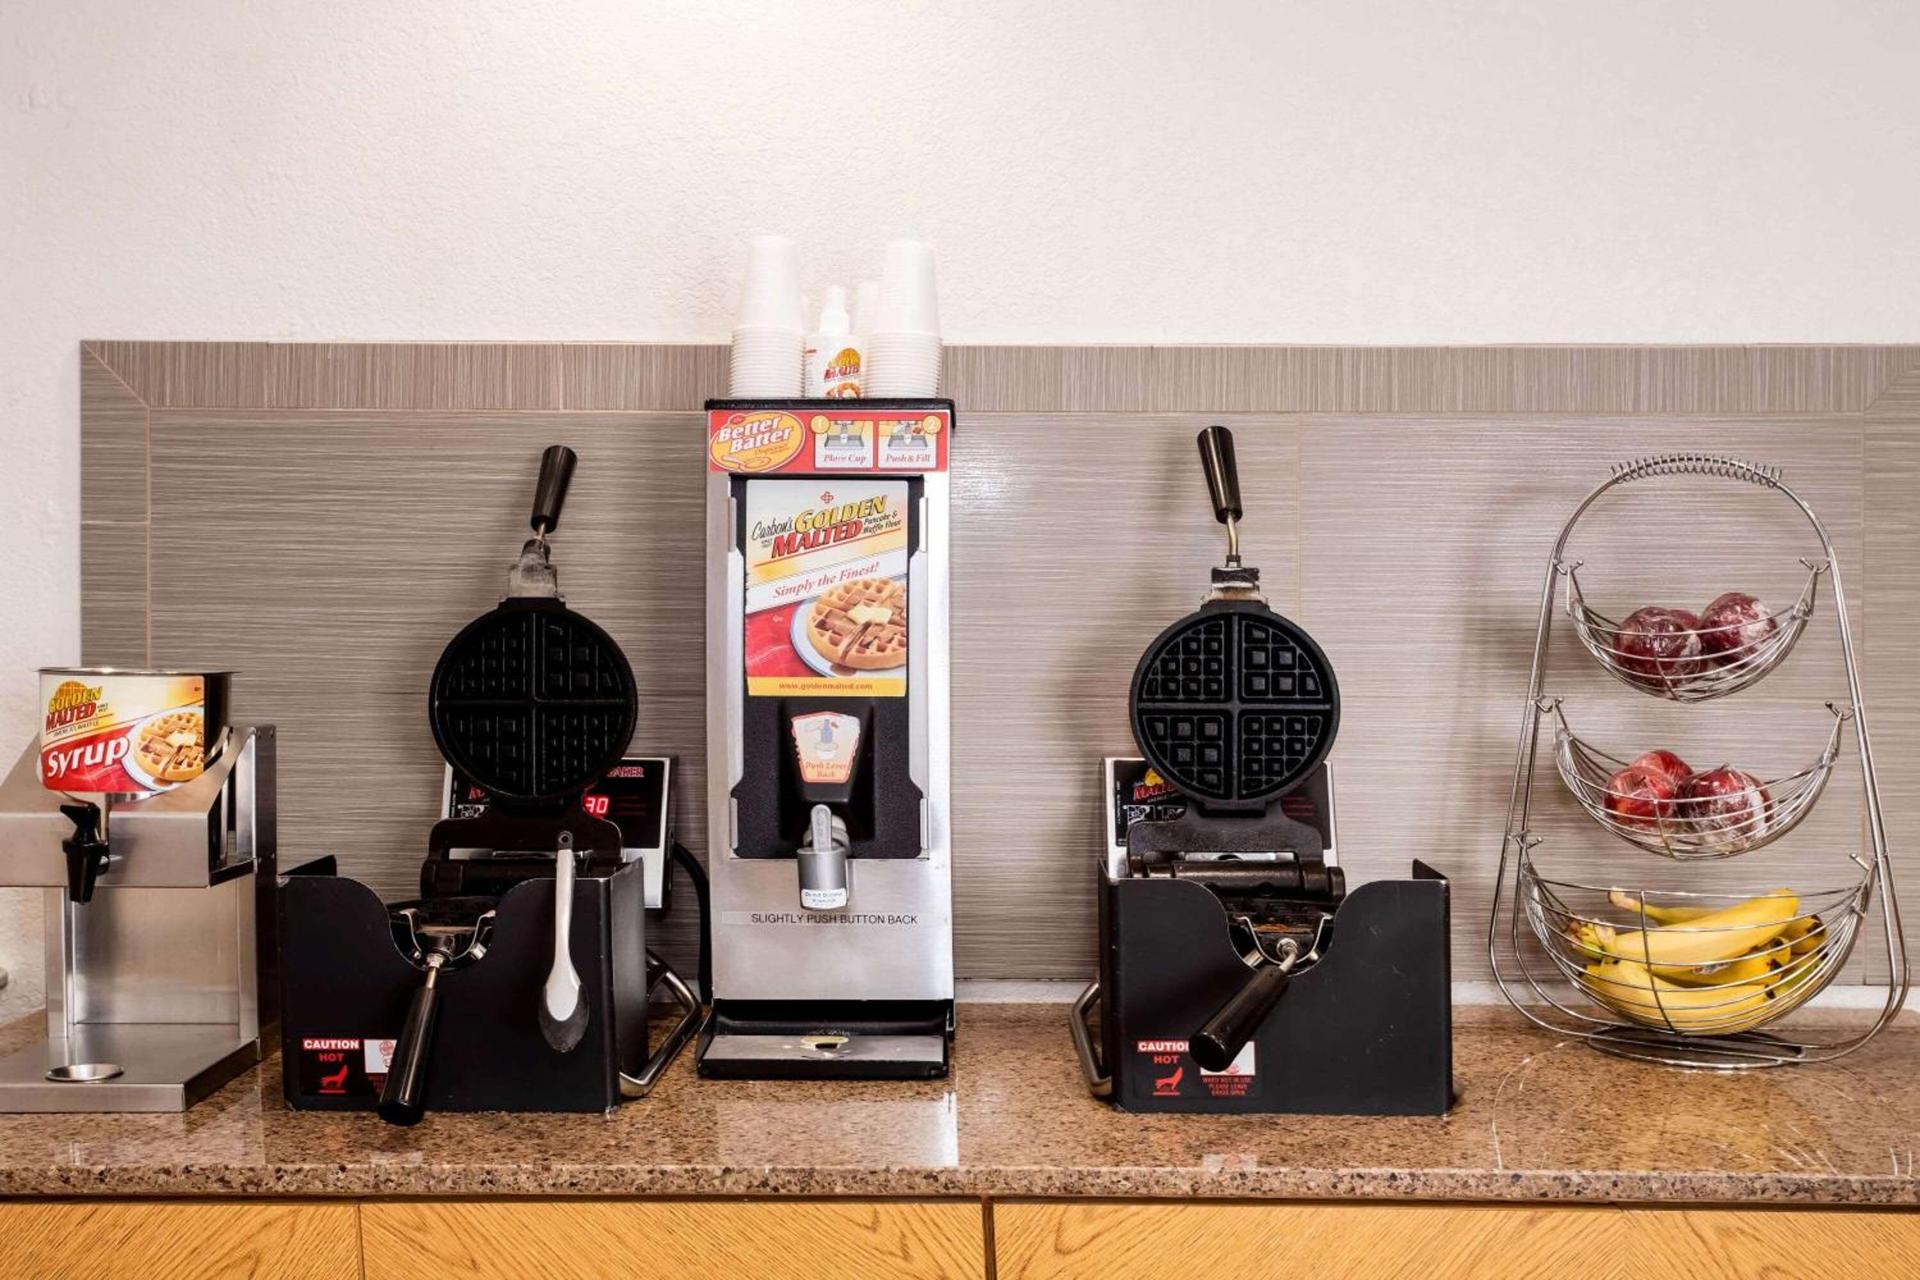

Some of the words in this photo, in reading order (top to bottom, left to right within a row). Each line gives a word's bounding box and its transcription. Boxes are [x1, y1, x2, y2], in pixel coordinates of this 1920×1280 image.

[718, 416, 781, 442] Better
[731, 427, 793, 453] Batter
[824, 453, 847, 463] Place
[848, 453, 866, 464] Cup
[915, 453, 931, 463] Fill
[794, 495, 887, 534] GOLDEN
[771, 520, 863, 559] MALTED
[772, 578, 817, 598] Simply
[818, 573, 837, 587] the
[839, 562, 880, 582] Finest!
[46, 702, 97, 735] MALTED
[48, 736, 129, 778] Syrup
[751, 913, 805, 924] SLIGHTLY
[807, 914, 837, 924] PUSH
[841, 914, 886, 924] BUTTON
[888, 914, 918, 925] BACK
[303, 1040, 360, 1050] CAUTION
[1138, 1041, 1189, 1052] CAUTIO
[319, 1053, 344, 1062] HOT
[1154, 1055, 1179, 1064] HOT
